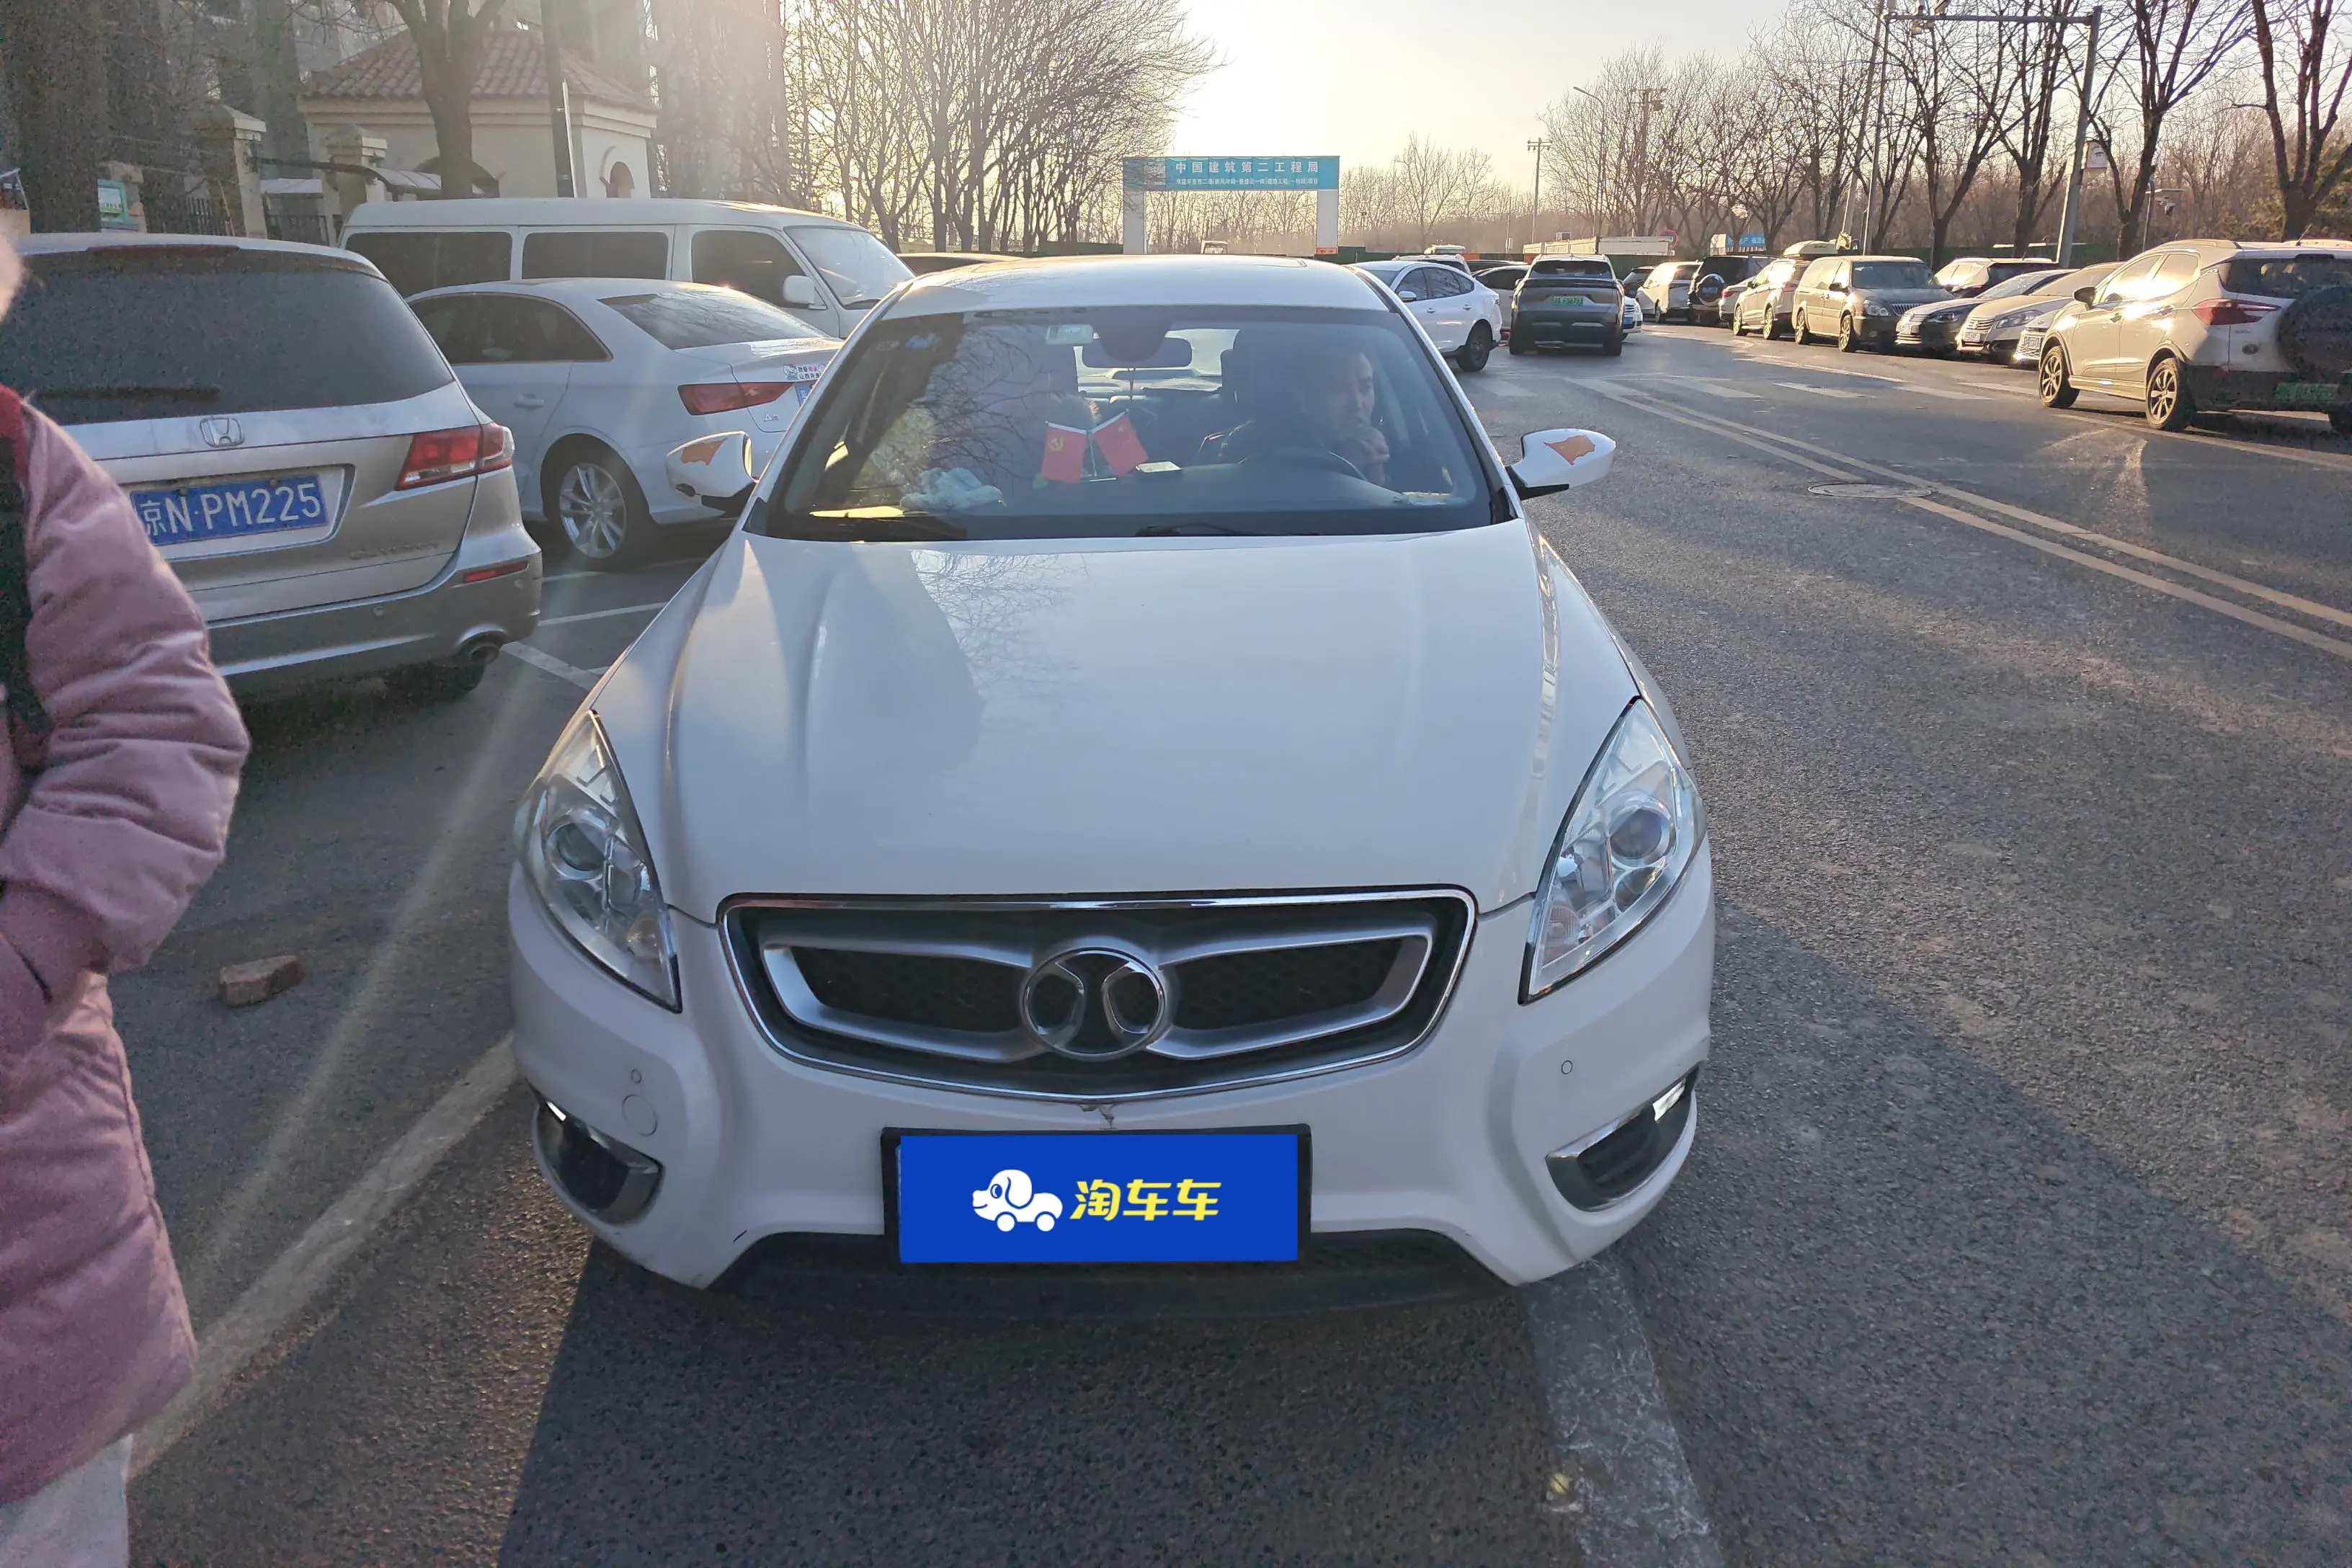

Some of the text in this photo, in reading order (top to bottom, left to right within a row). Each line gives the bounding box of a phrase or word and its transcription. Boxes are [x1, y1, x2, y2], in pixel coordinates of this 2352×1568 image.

[1175, 161, 1319, 174] 中国建筑第二工程局
